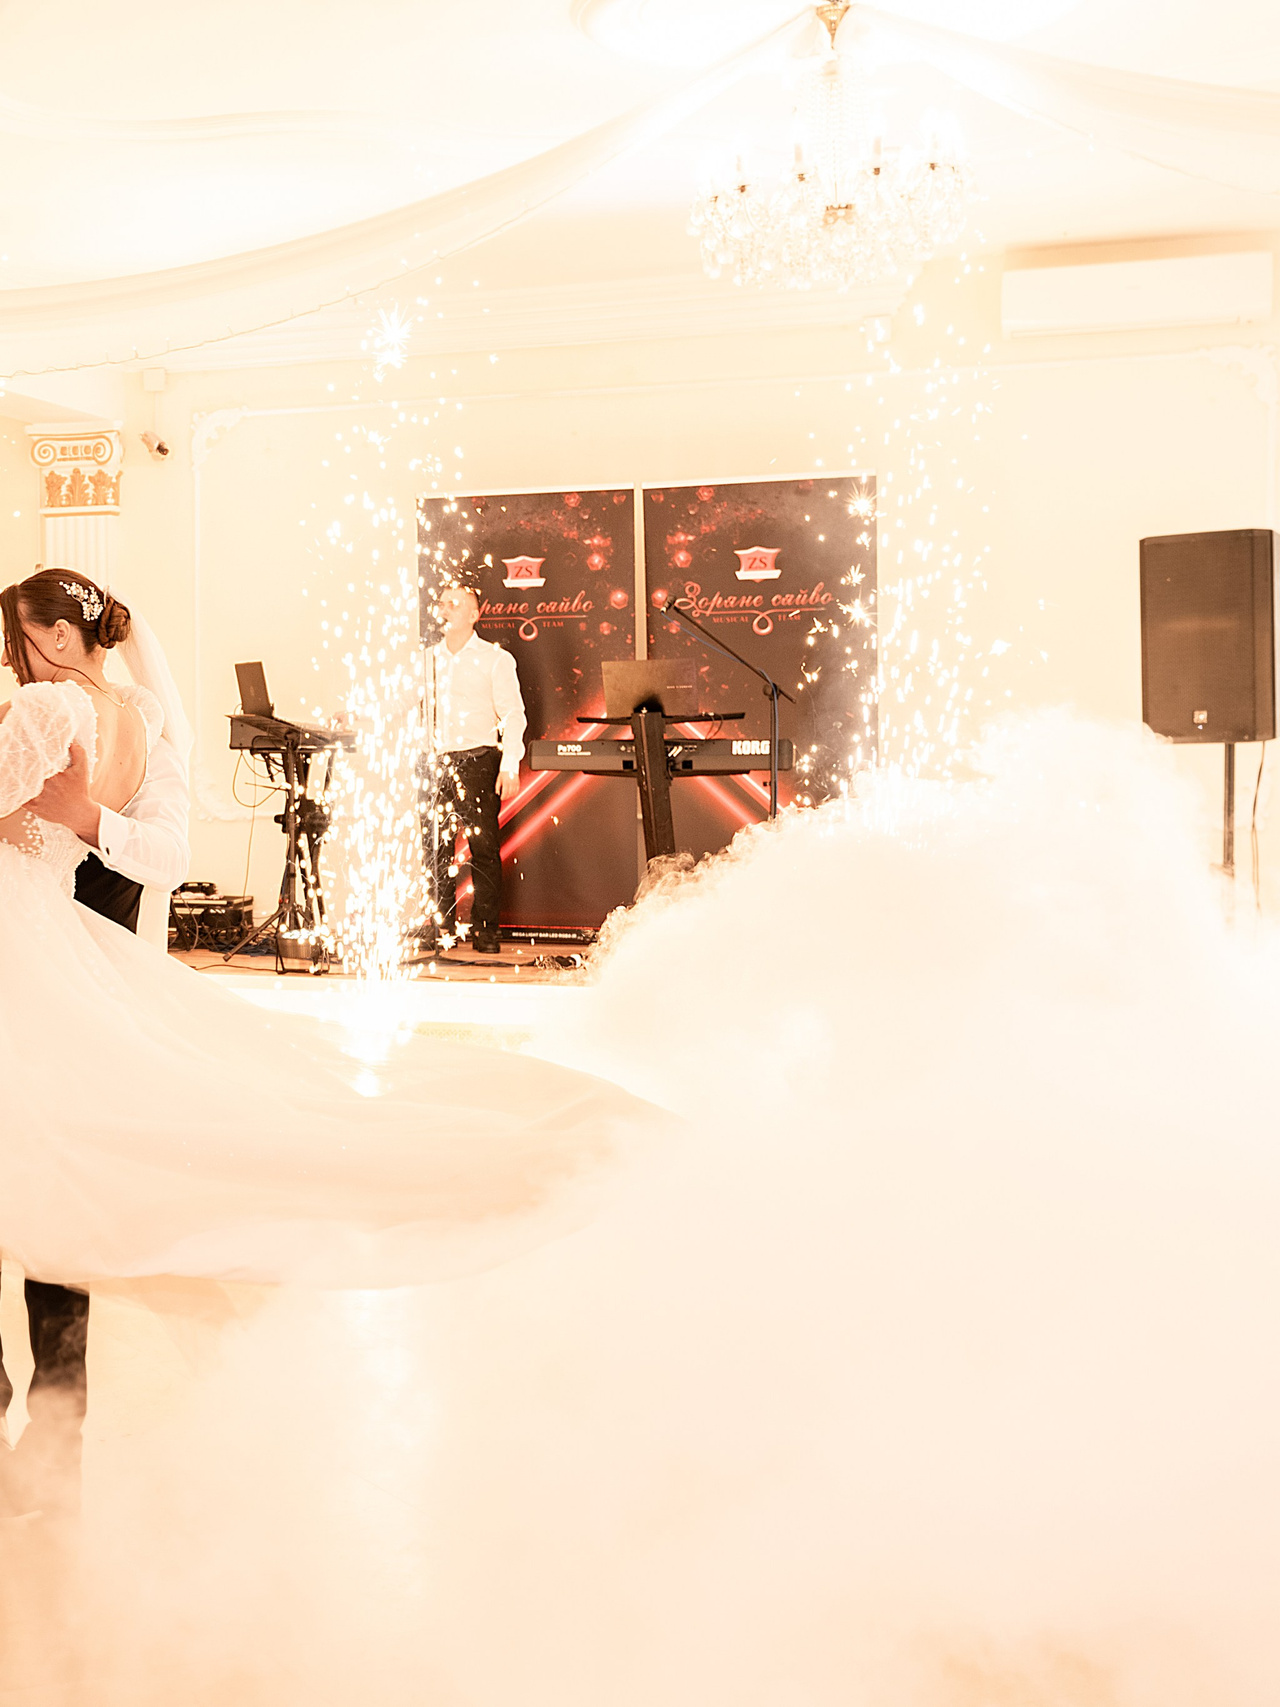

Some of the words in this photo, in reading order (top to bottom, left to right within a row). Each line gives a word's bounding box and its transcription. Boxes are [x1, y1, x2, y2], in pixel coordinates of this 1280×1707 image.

[747, 556, 768, 570] ZS
[514, 565, 533, 578] ZS
[675, 581, 764, 617] Зоряне
[479, 598, 530, 618] ряне
[712, 615, 748, 623] MUSICAL
[731, 740, 770, 756] KORG
